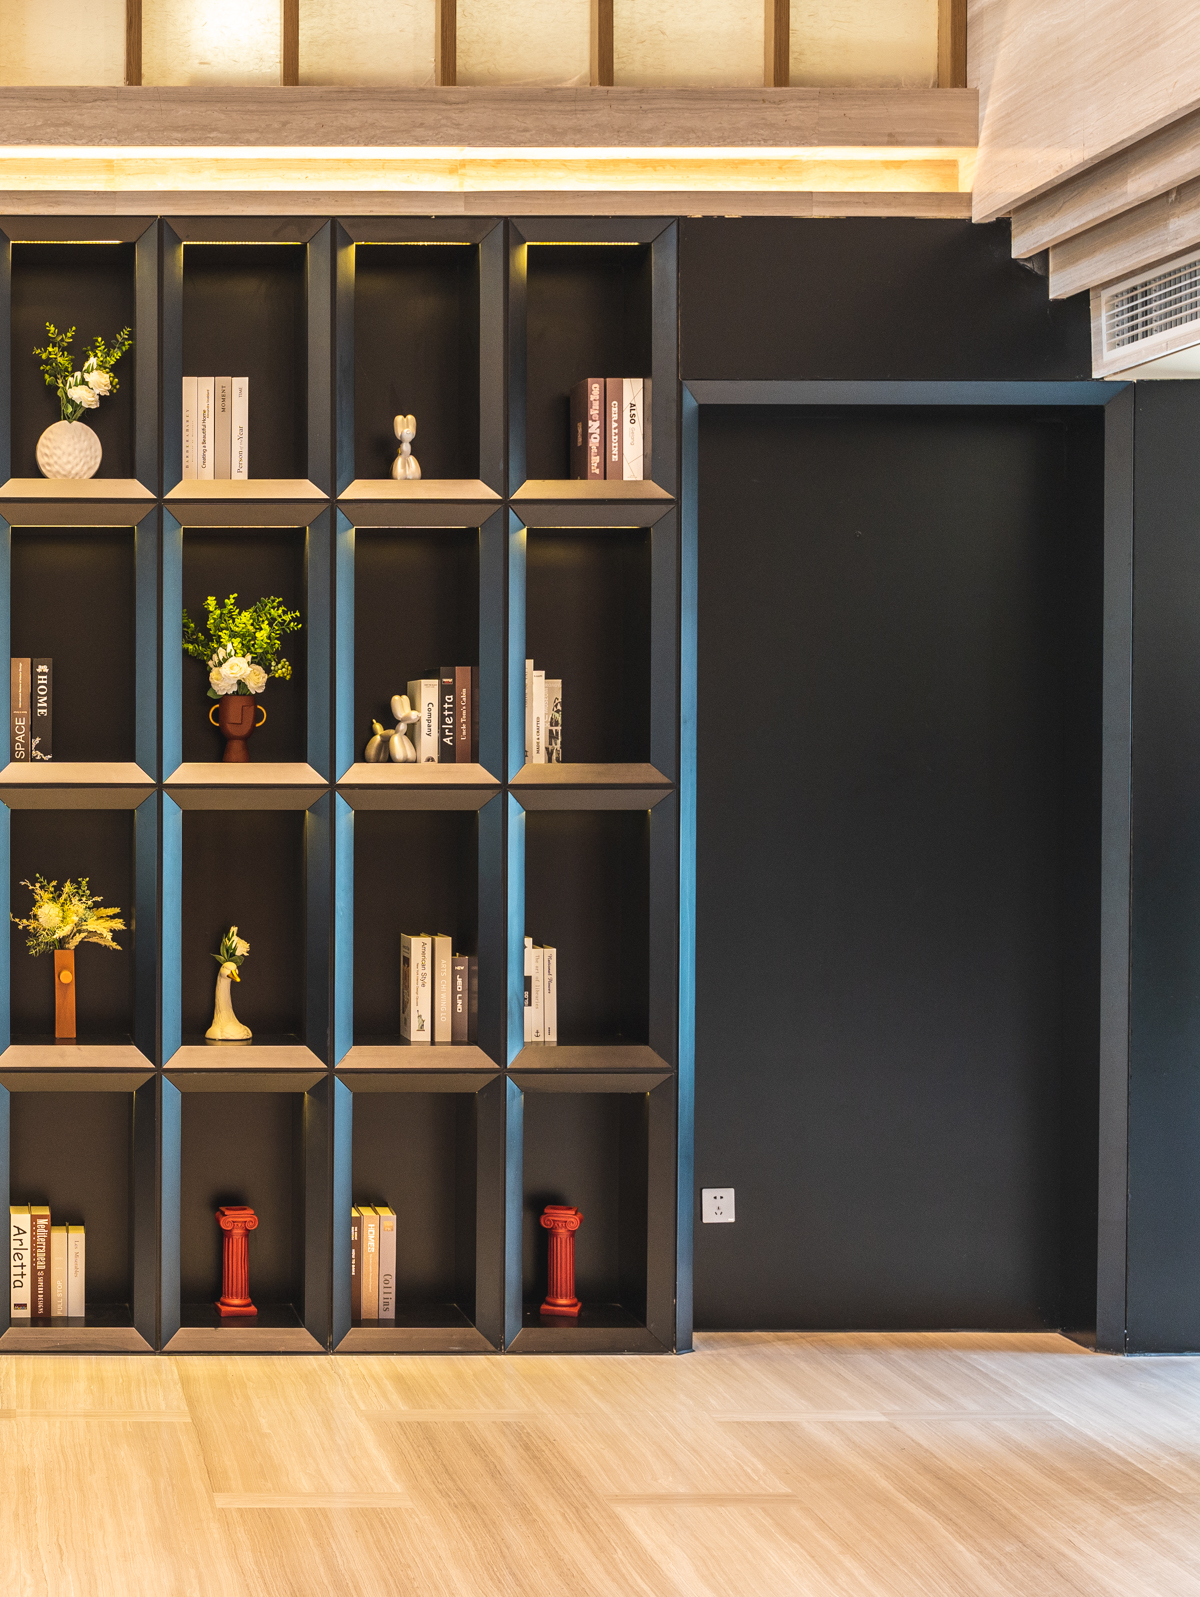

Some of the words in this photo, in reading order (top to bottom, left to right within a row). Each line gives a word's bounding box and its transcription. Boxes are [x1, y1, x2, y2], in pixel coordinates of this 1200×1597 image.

[37, 675, 47, 716] HOME
[15, 717, 25, 759] SPACE
[426, 703, 434, 737] Company
[442, 695, 453, 745] Arletta
[441, 1013, 446, 1022] LO
[13, 1225, 28, 1288] Arletta
[37, 1219, 48, 1269] Mediterranean
[383, 1274, 392, 1312] Collins
